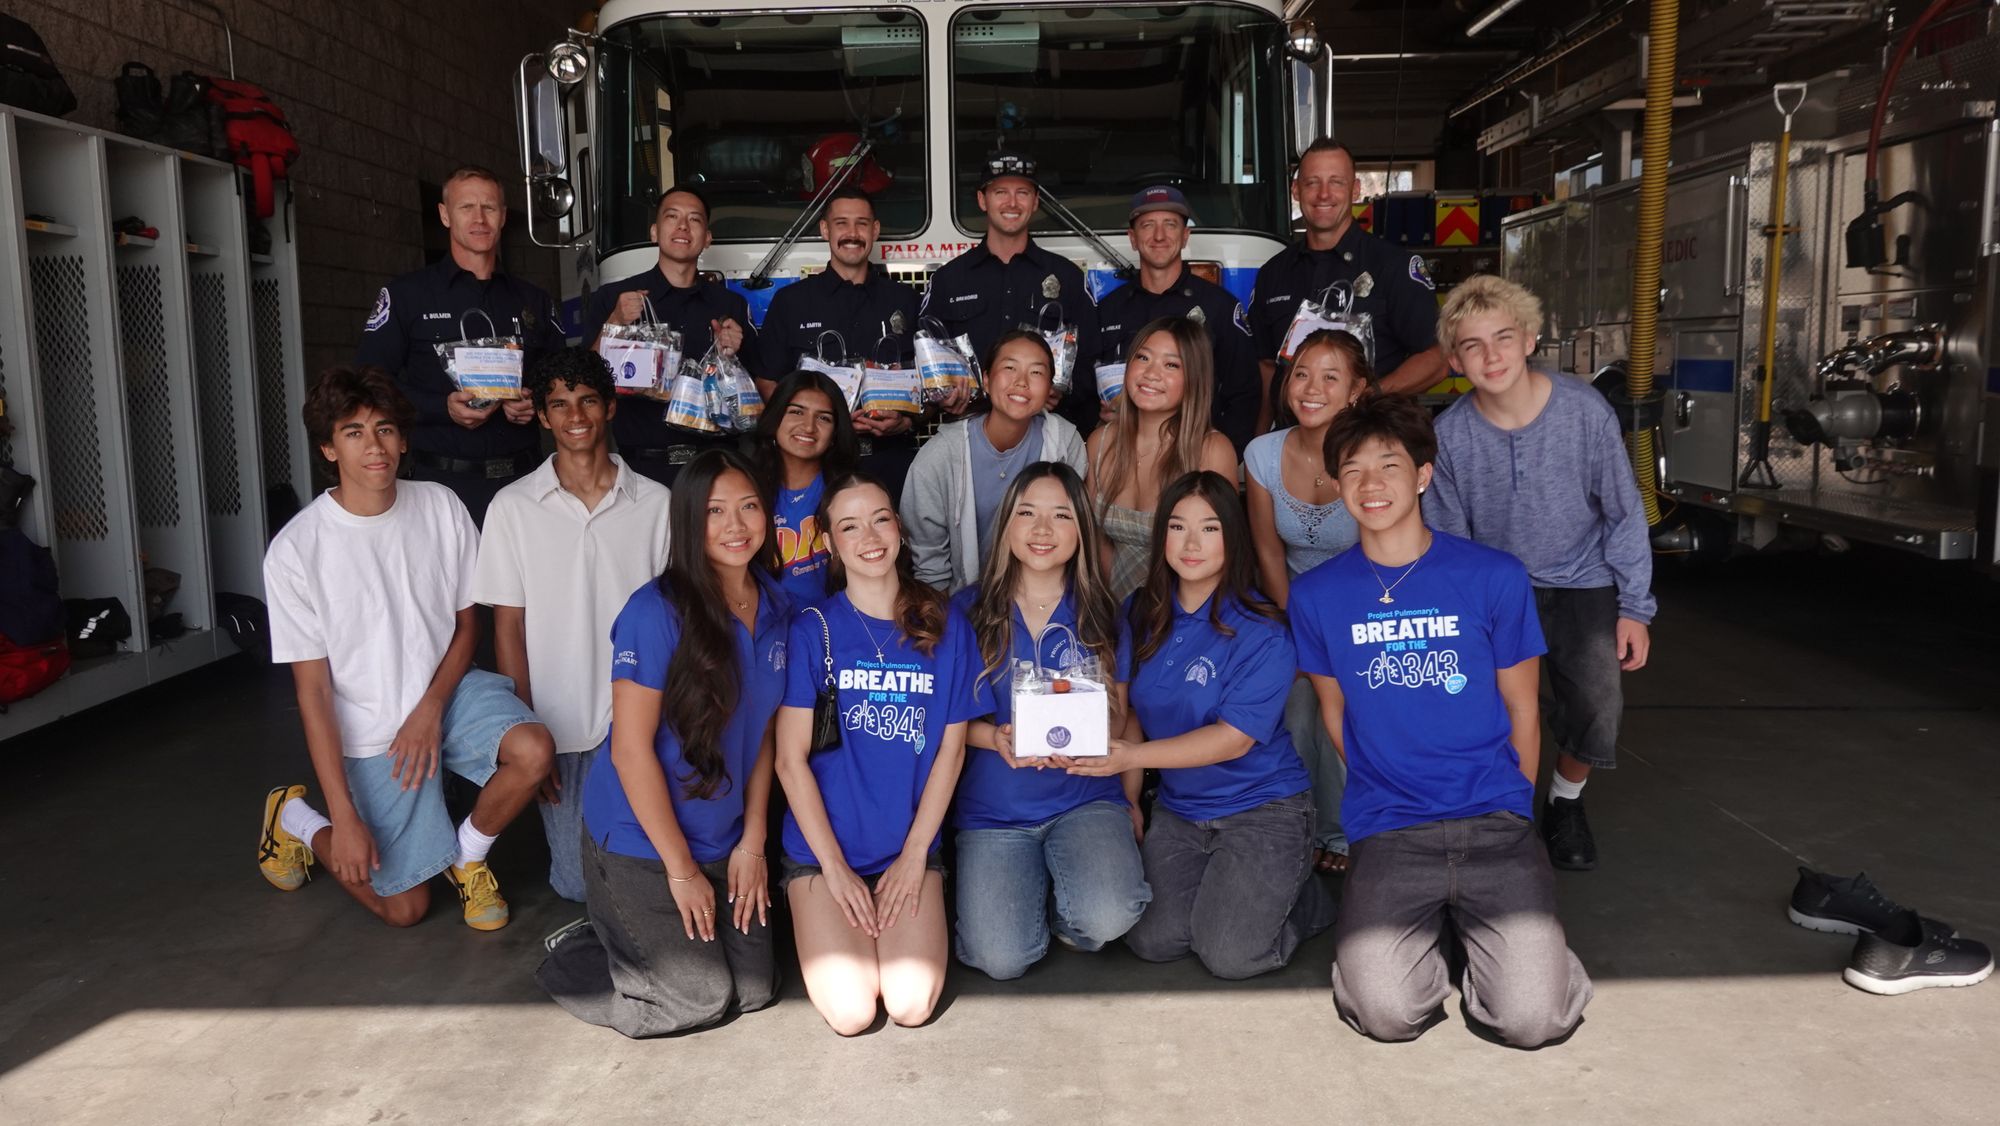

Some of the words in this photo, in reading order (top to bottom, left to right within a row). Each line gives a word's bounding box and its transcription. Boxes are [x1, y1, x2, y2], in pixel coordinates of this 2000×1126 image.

[881, 243, 981, 260] PARAME
[1367, 611, 1393, 620] Project
[1394, 607, 1440, 617] Pulmonary's
[1351, 615, 1460, 645] BREATHE
[1386, 641, 1406, 652] FOR
[1407, 640, 1428, 650] THE
[856, 660, 880, 668] Project
[880, 661, 921, 671] Pulmonary's
[1402, 649, 1459, 688] 343
[839, 669, 934, 695] BREATHE
[868, 692, 887, 702] FOR
[889, 693, 908, 703] THE
[880, 705, 926, 742] 343
